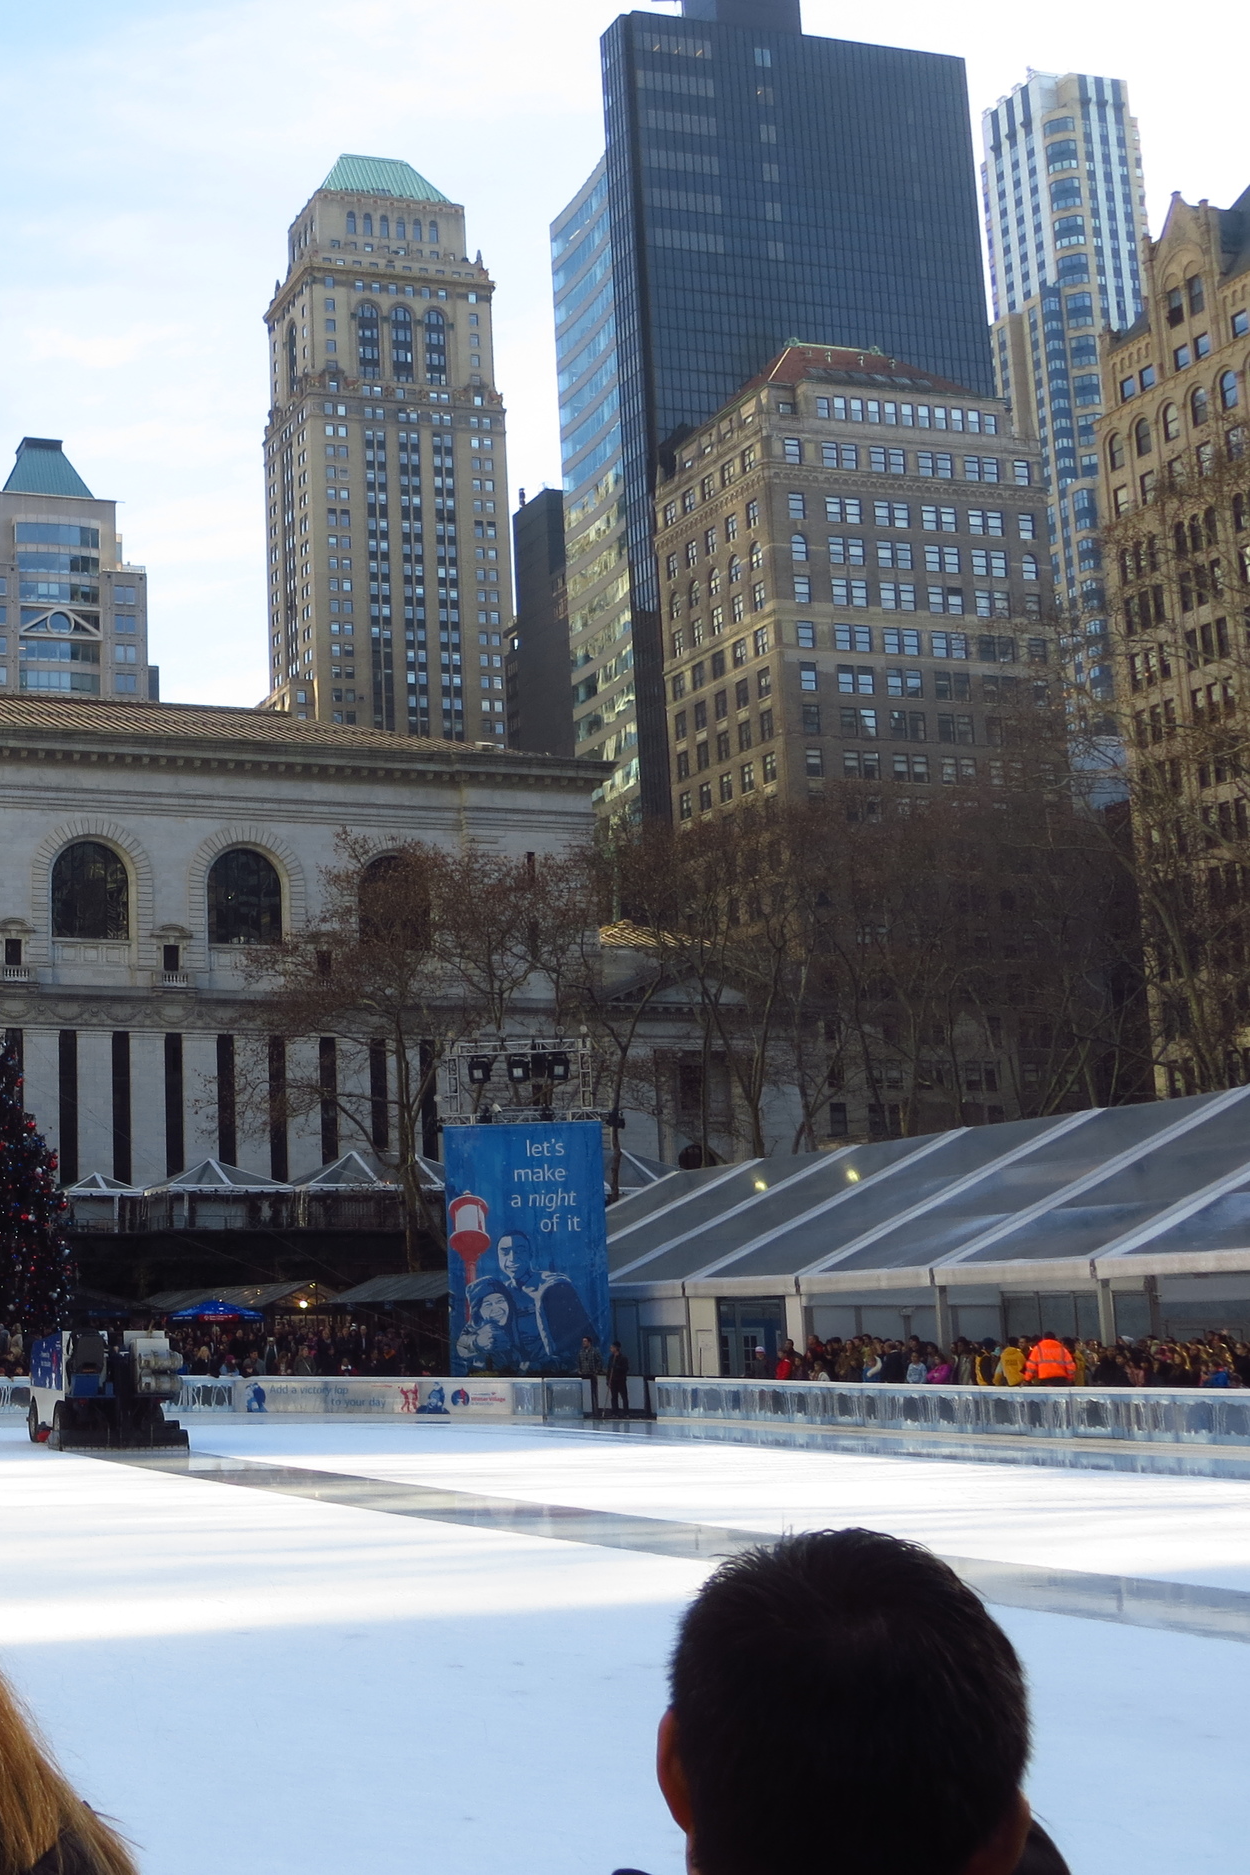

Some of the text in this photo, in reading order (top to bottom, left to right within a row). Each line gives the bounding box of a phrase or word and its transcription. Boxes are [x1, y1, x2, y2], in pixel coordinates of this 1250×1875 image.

[526, 1138, 565, 1157] let's
[514, 1164, 566, 1182] make
[511, 1188, 577, 1212] a night
[540, 1213, 581, 1232] of it
[270, 1385, 288, 1394] Add
[300, 1385, 331, 1396] victory
[334, 1385, 349, 1396] lap
[331, 1397, 386, 1408] to your day
